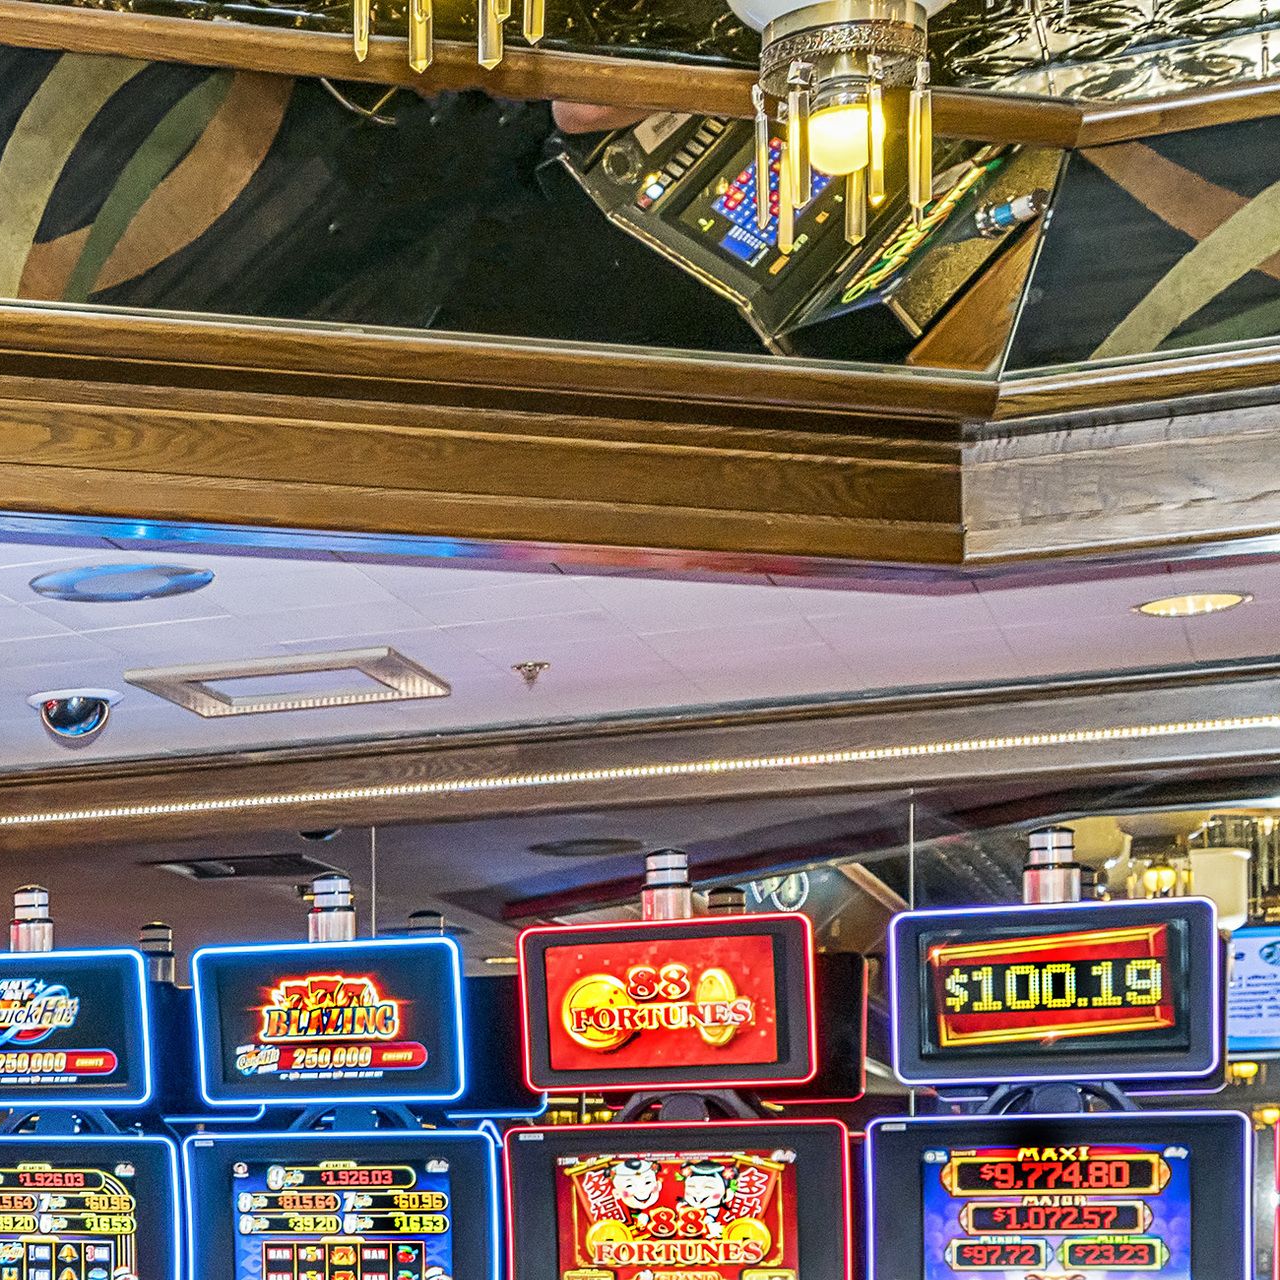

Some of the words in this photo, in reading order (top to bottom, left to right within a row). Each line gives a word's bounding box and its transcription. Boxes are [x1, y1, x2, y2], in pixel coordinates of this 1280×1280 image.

[626, 965, 691, 1001] 88
[944, 959, 1163, 1012] $100.19
[266, 1005, 395, 1037] BLAZING
[569, 999, 755, 1032] FORTUNES
[291, 1047, 372, 1070] 250,000
[1017, 1147, 1090, 1161] MAXI
[980, 1162, 1130, 1189] $9,774.80
[1022, 1196, 1087, 1206] MAJOR
[649, 1207, 706, 1237] 88
[593, 1241, 764, 1265] FORTUNES
[962, 1246, 1035, 1265] $97.72
[1075, 1246, 1149, 1264] $23.23
